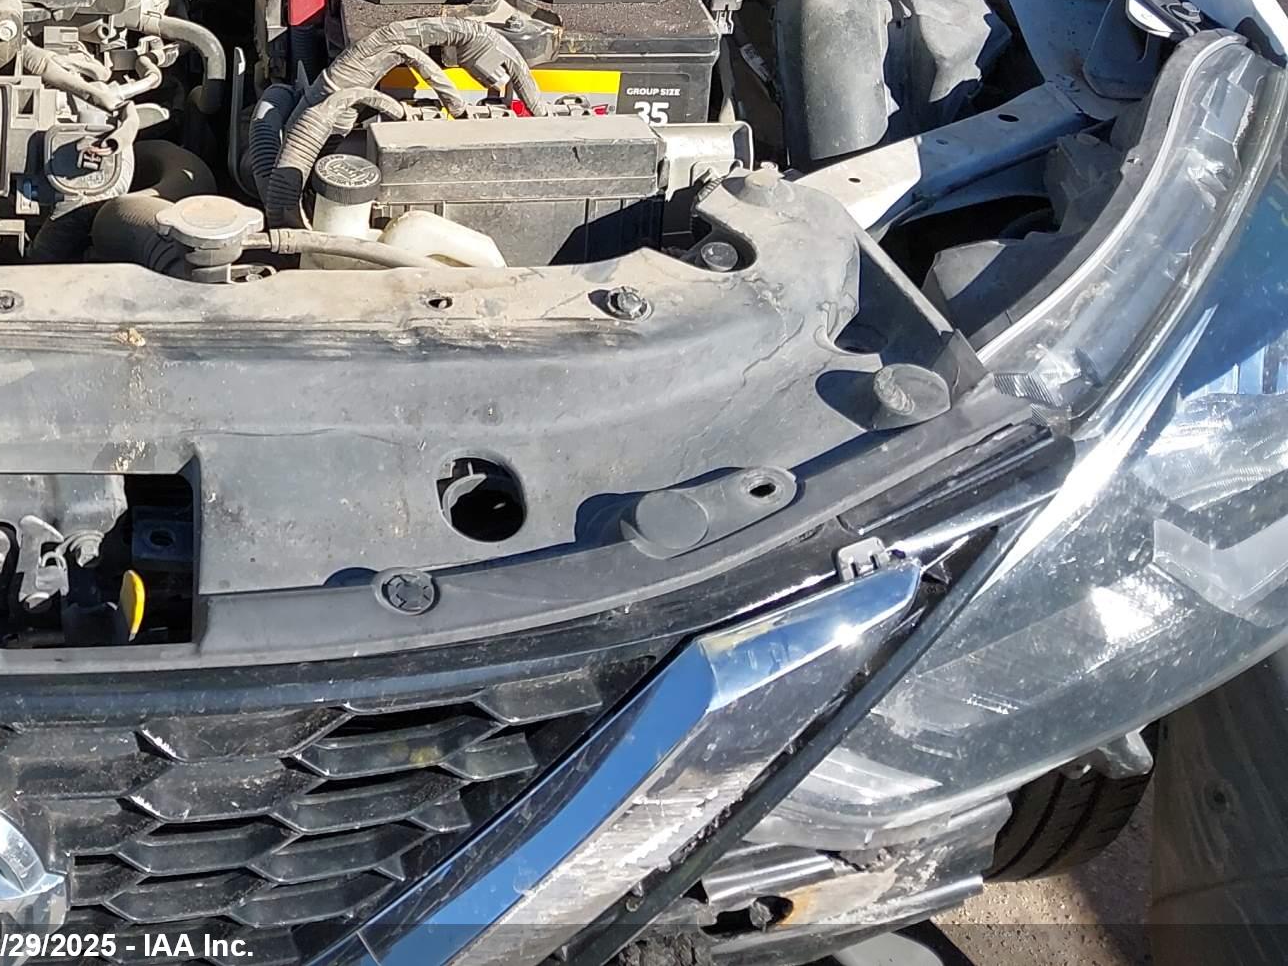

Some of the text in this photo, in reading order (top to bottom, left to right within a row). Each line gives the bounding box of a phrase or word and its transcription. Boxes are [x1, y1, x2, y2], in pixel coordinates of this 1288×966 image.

[626, 87, 681, 96] GROUP SIZE
[634, 101, 669, 127] 35
